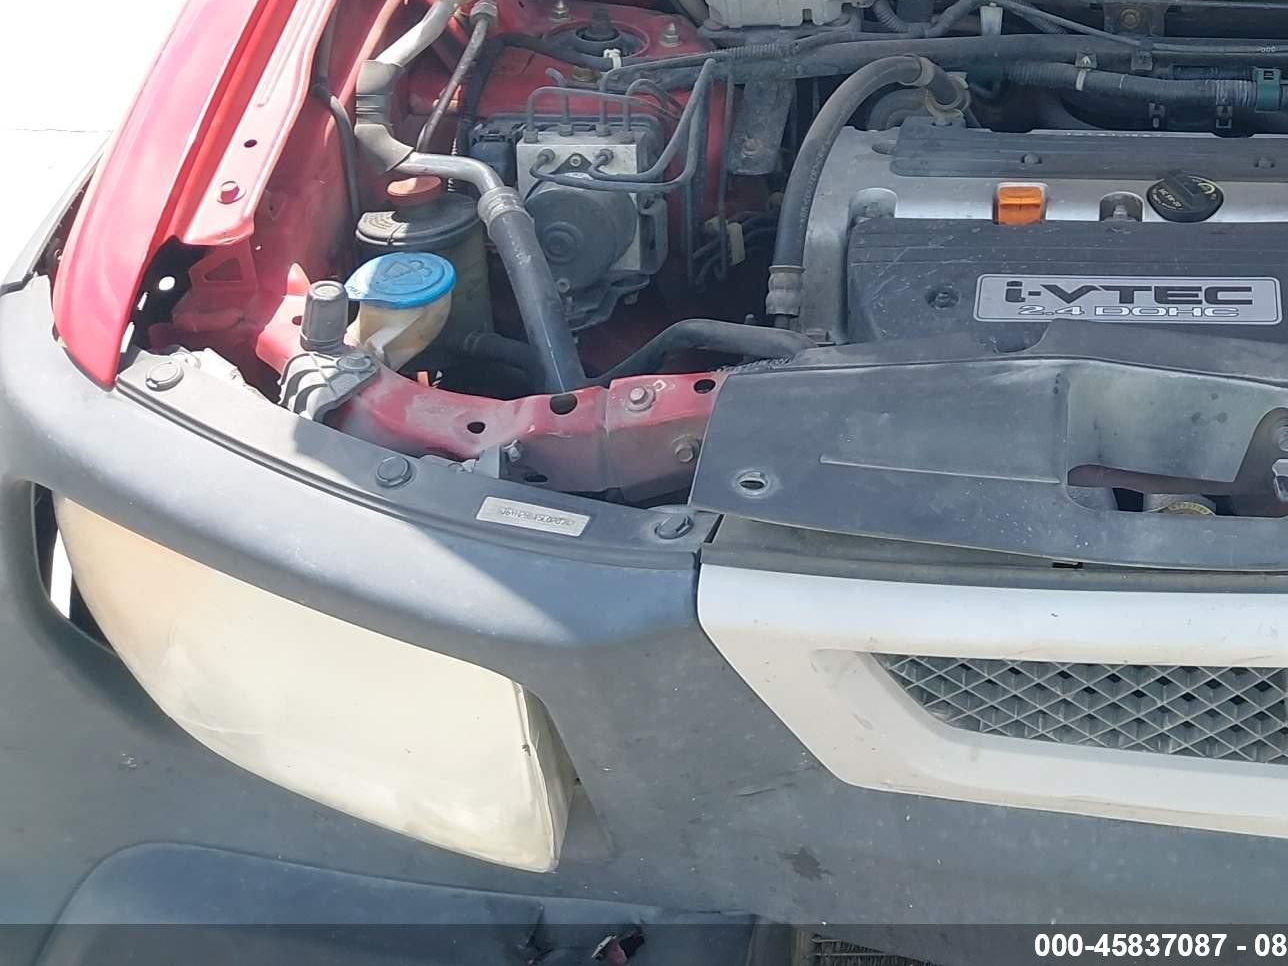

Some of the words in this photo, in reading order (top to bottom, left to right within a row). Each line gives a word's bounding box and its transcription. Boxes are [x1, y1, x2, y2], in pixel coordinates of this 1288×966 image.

[1004, 280, 1253, 305] i-VTEC
[1017, 305, 1085, 316] 2.4
[1094, 305, 1239, 318] DOHC
